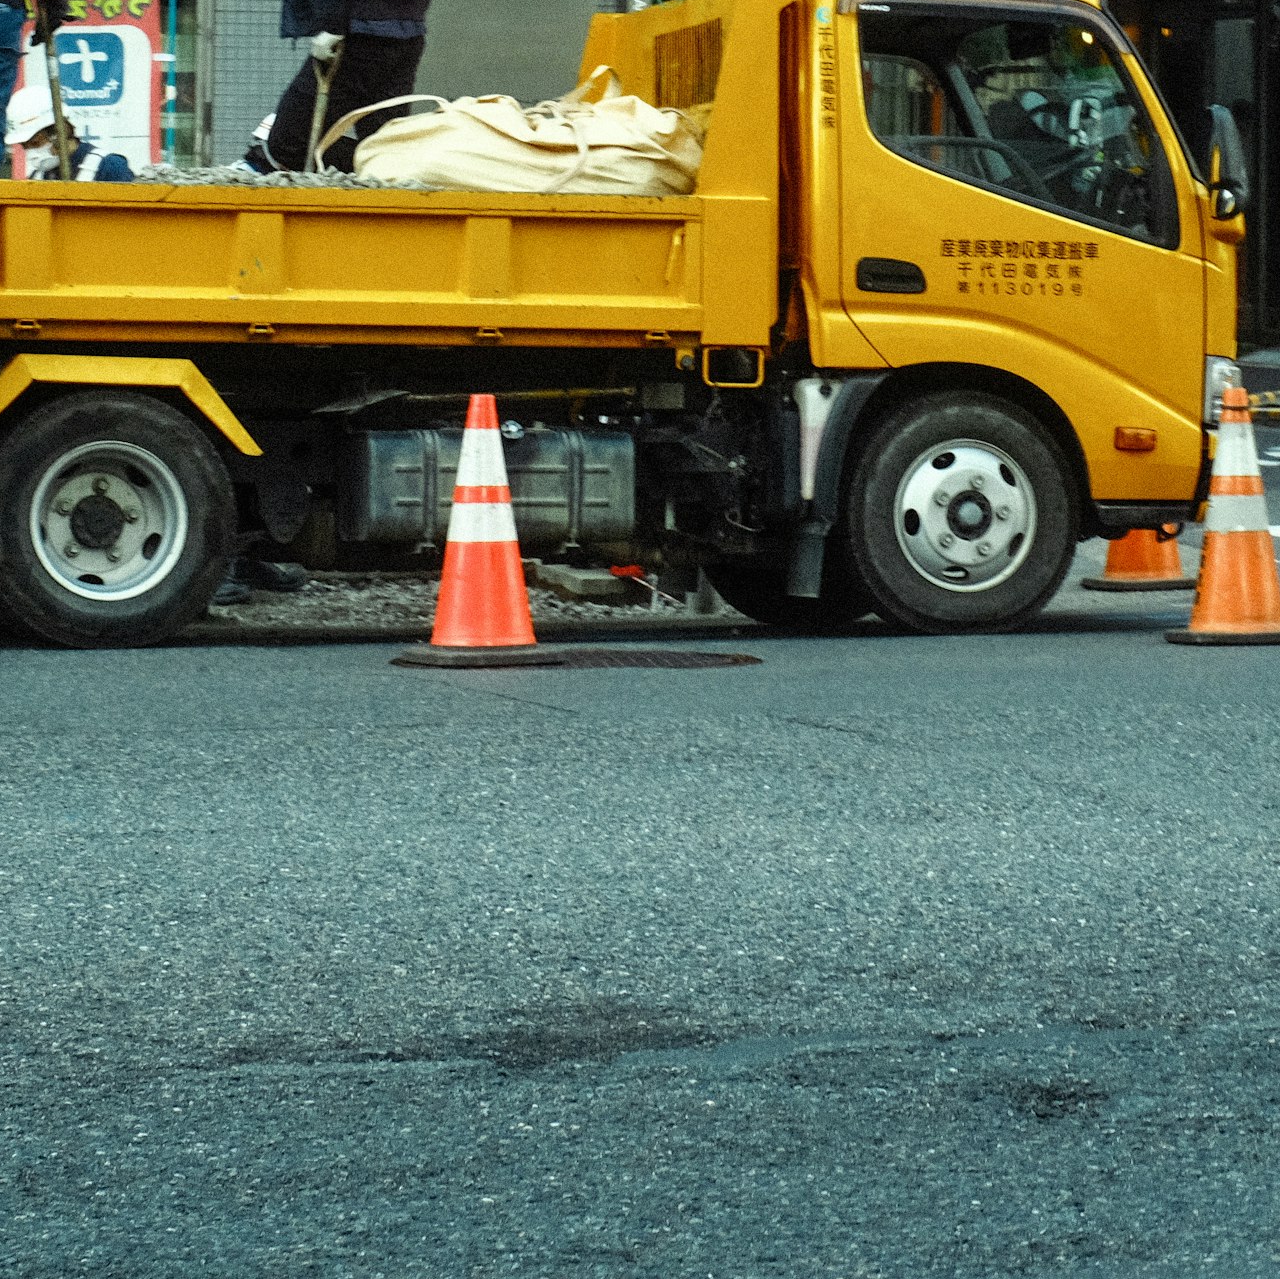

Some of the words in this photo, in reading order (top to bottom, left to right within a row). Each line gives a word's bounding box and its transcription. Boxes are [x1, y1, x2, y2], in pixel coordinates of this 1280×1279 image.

[940, 239, 1099, 260] 産業廃棄物収集運搬車
